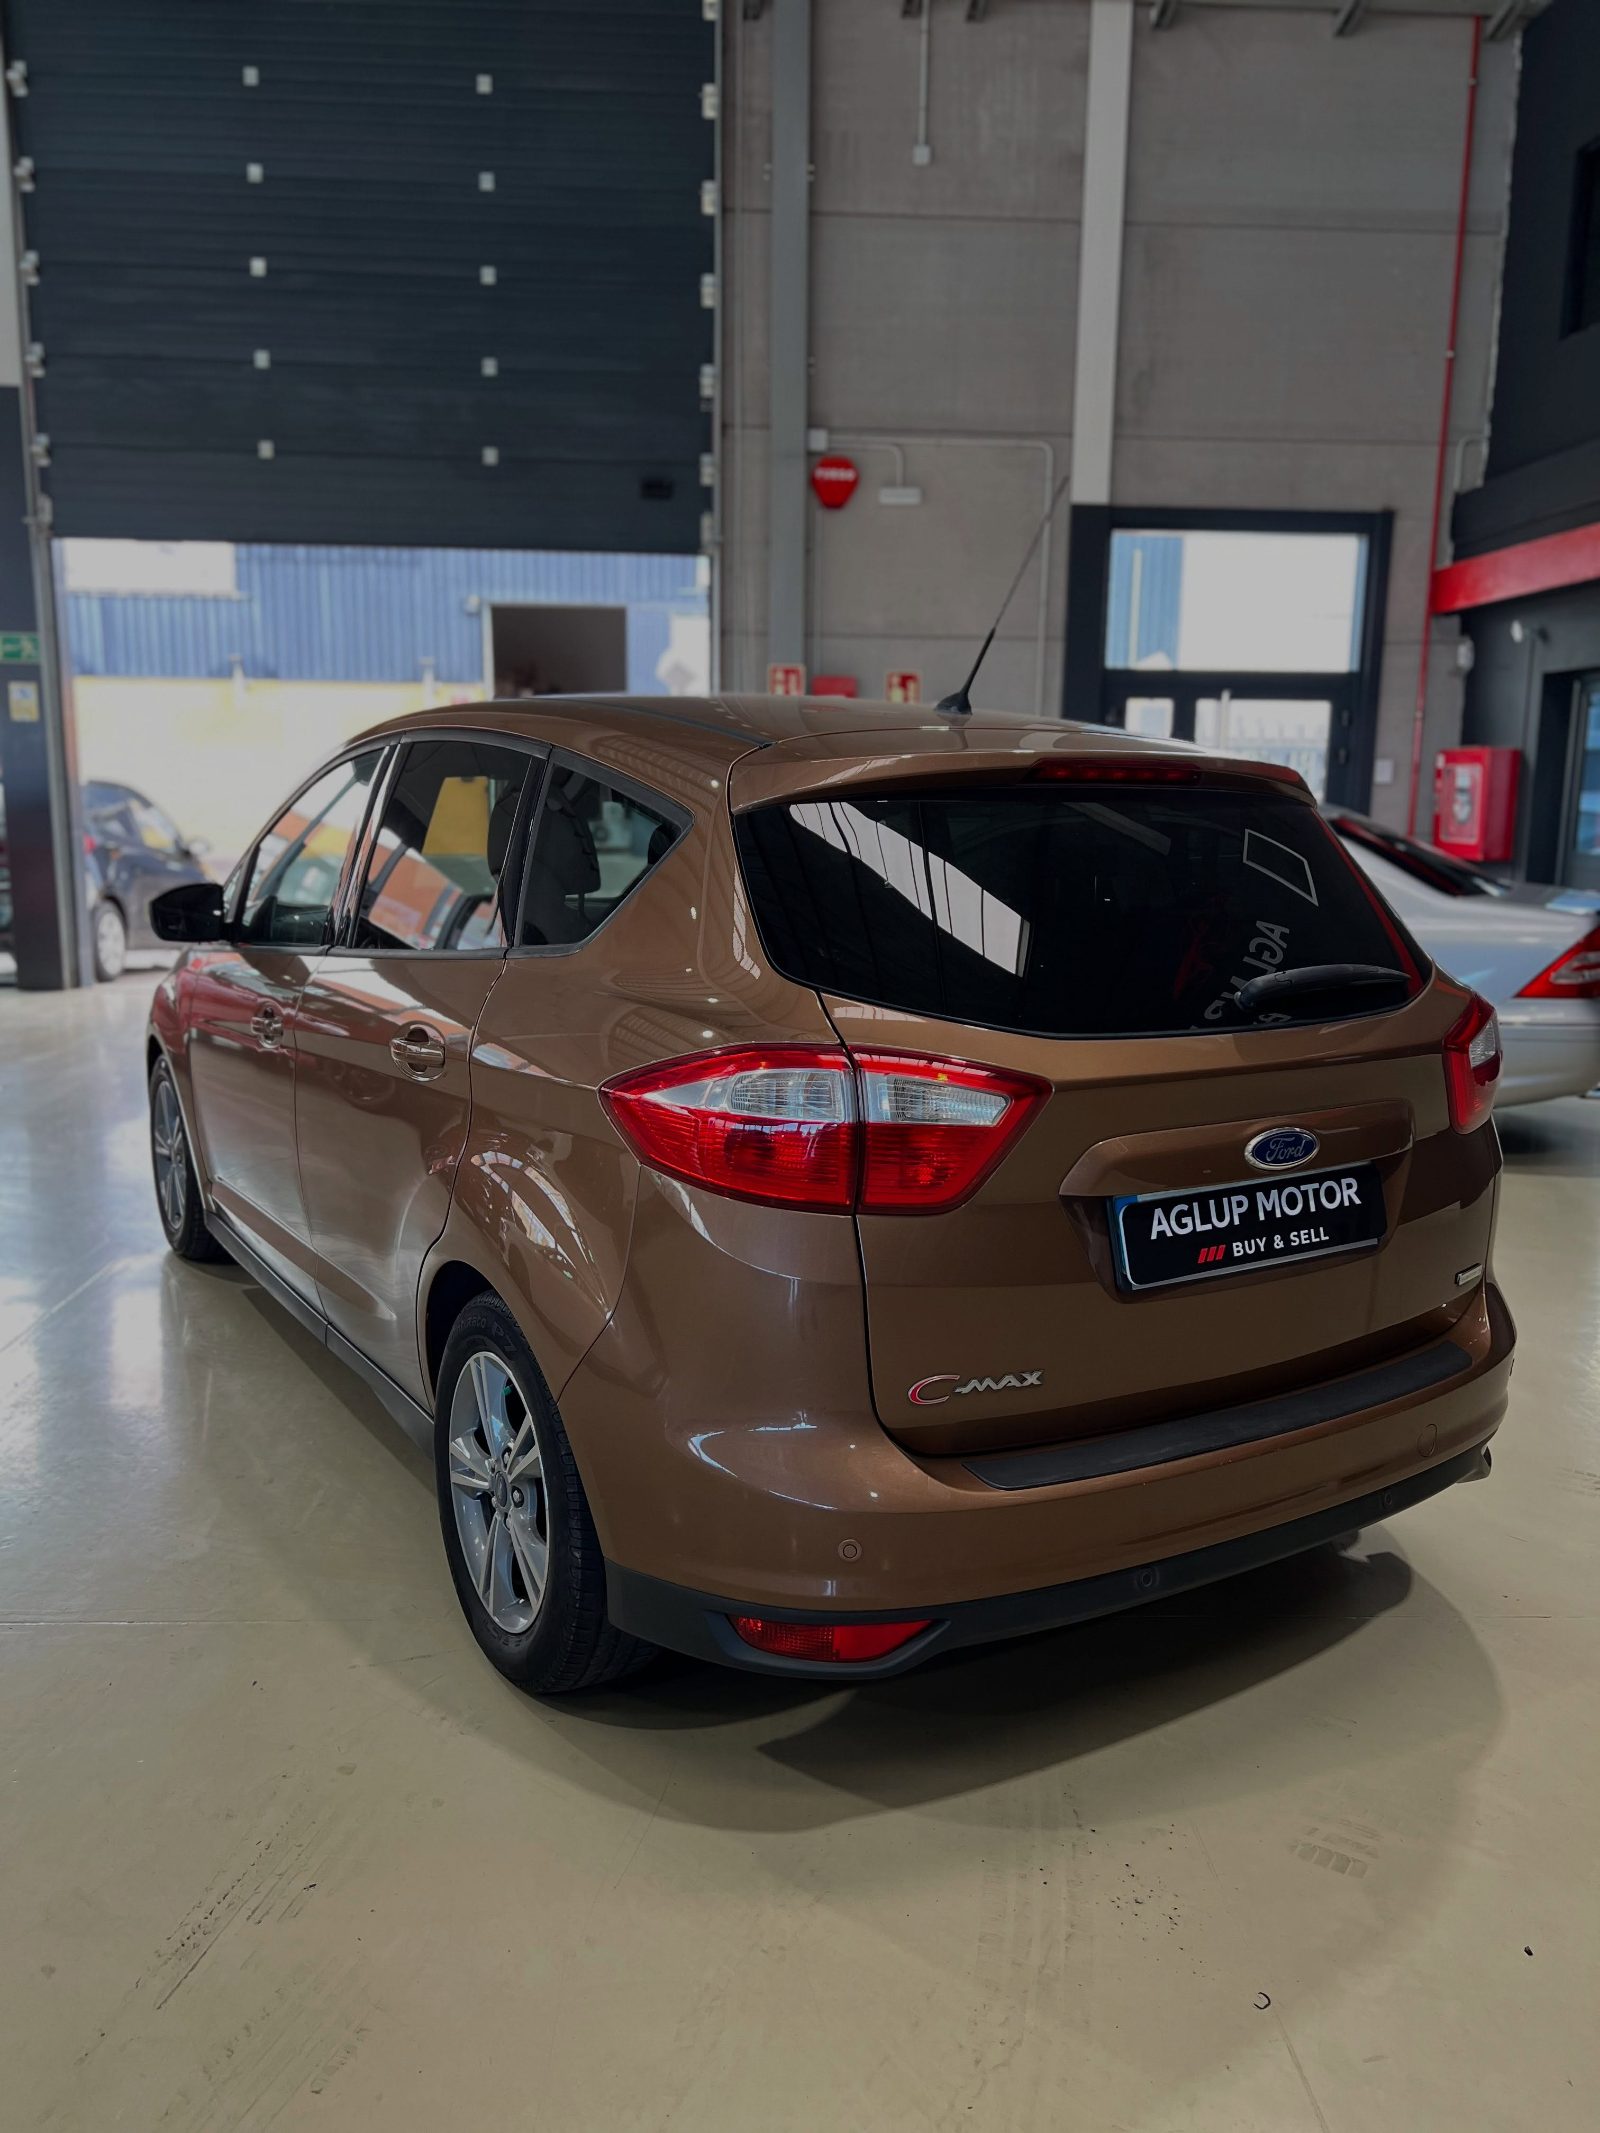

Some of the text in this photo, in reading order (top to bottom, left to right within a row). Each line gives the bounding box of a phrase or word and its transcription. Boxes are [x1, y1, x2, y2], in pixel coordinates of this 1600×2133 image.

[1265, 1136, 1307, 1162] Ford
[1150, 1177, 1362, 1240] AGLUP MOTOR
[1232, 1226, 1330, 1257] BUY & SELL
